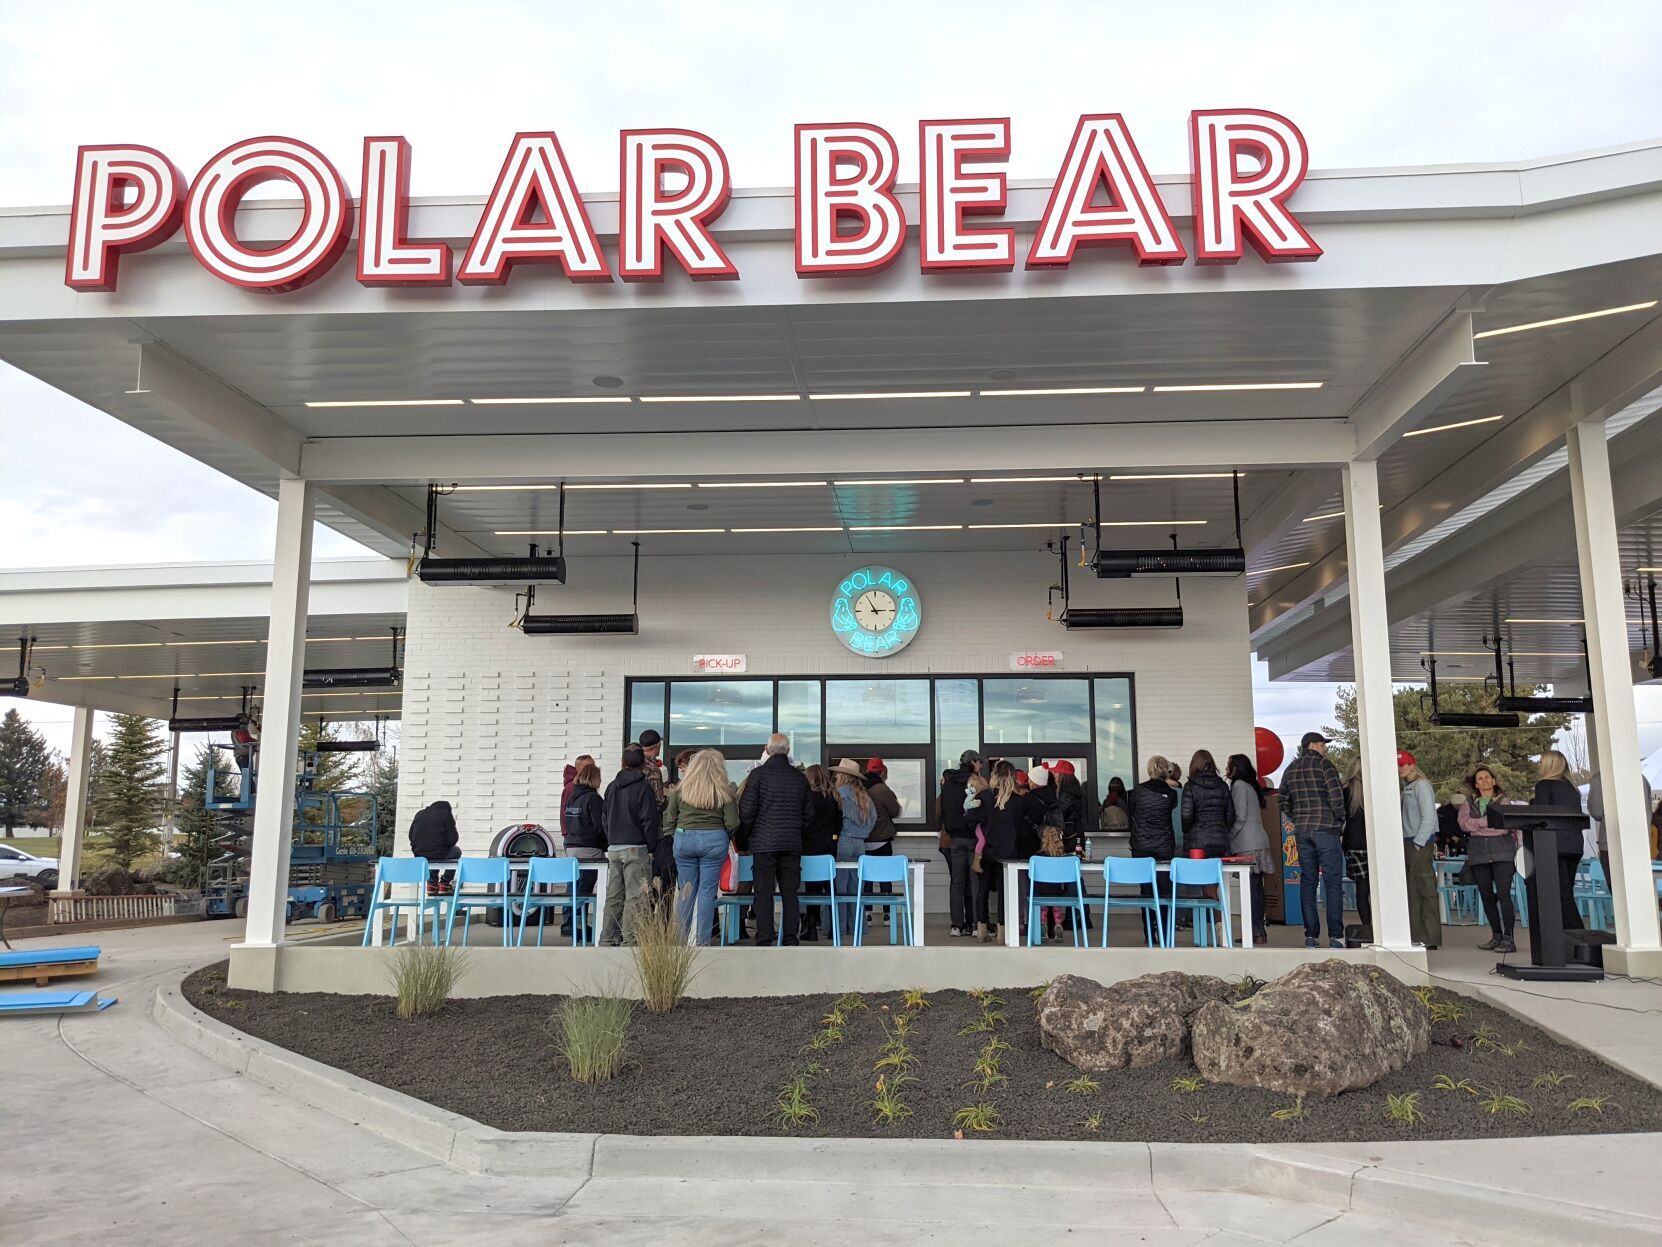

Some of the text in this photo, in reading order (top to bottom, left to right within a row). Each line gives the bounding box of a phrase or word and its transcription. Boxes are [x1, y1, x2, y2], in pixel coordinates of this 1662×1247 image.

[65, 108, 1325, 293] POLAR BEAR
[840, 569, 908, 598] POLAR
[848, 630, 902, 652] BEAR
[698, 658, 741, 669] PICK-UP
[1017, 655, 1055, 666] ORDER
